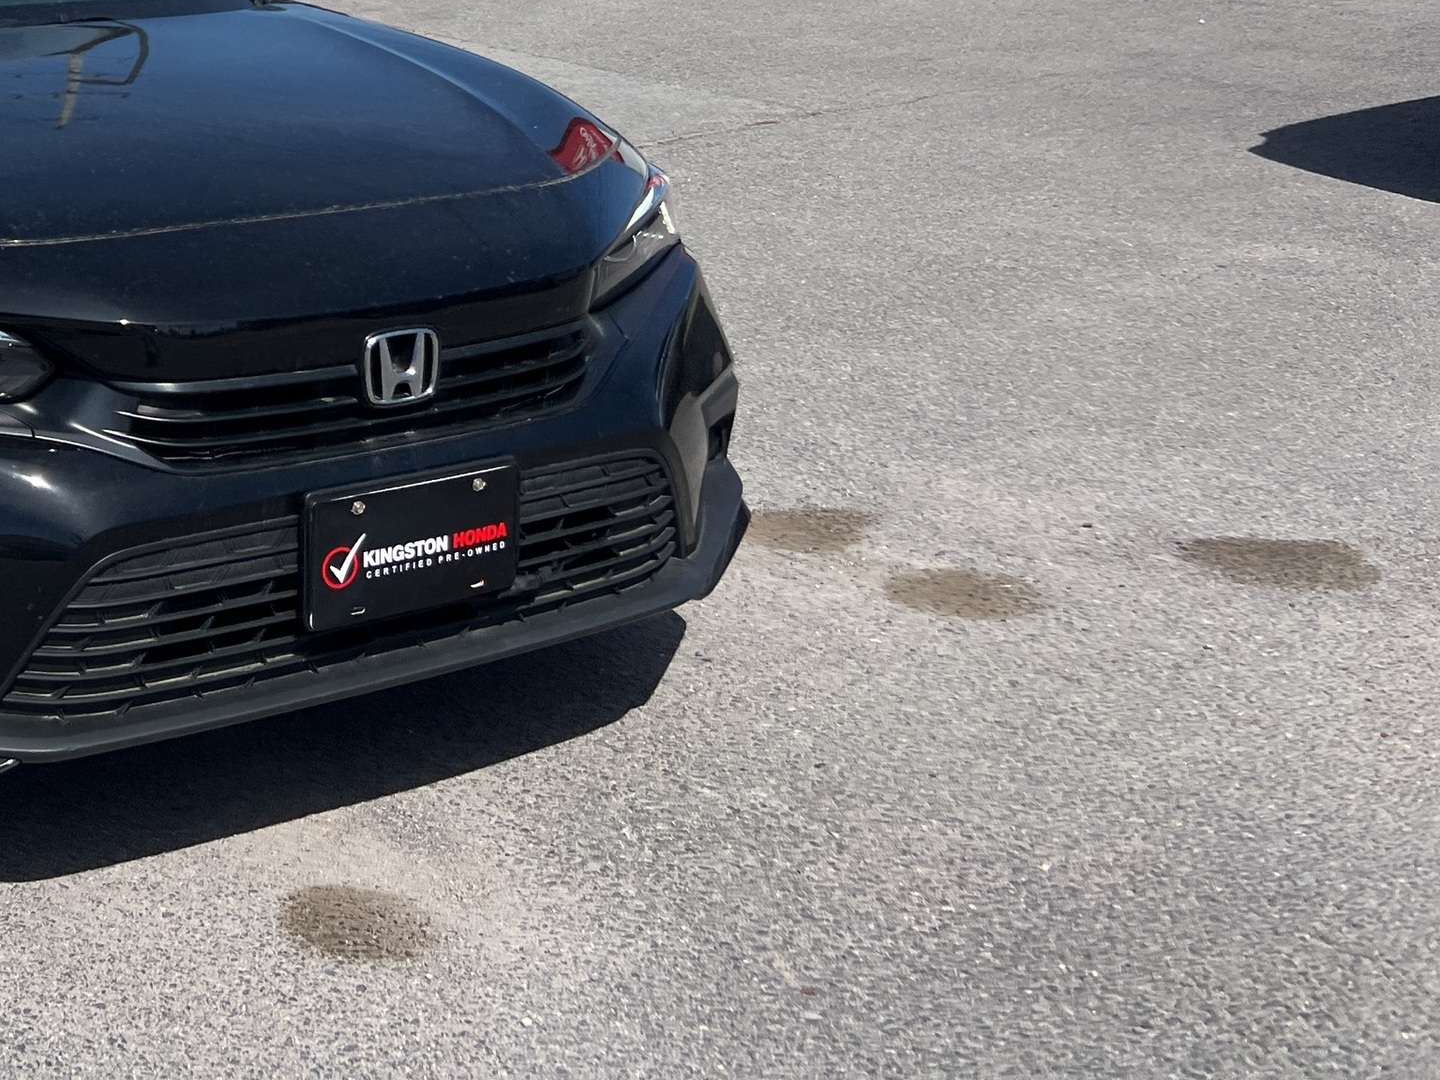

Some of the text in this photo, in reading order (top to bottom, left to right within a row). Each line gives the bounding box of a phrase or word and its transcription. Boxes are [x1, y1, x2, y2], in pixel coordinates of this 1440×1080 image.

[363, 522, 507, 567] KINGSTON HONDA
[366, 540, 505, 579] CERTIFIED PRE-OWNED
